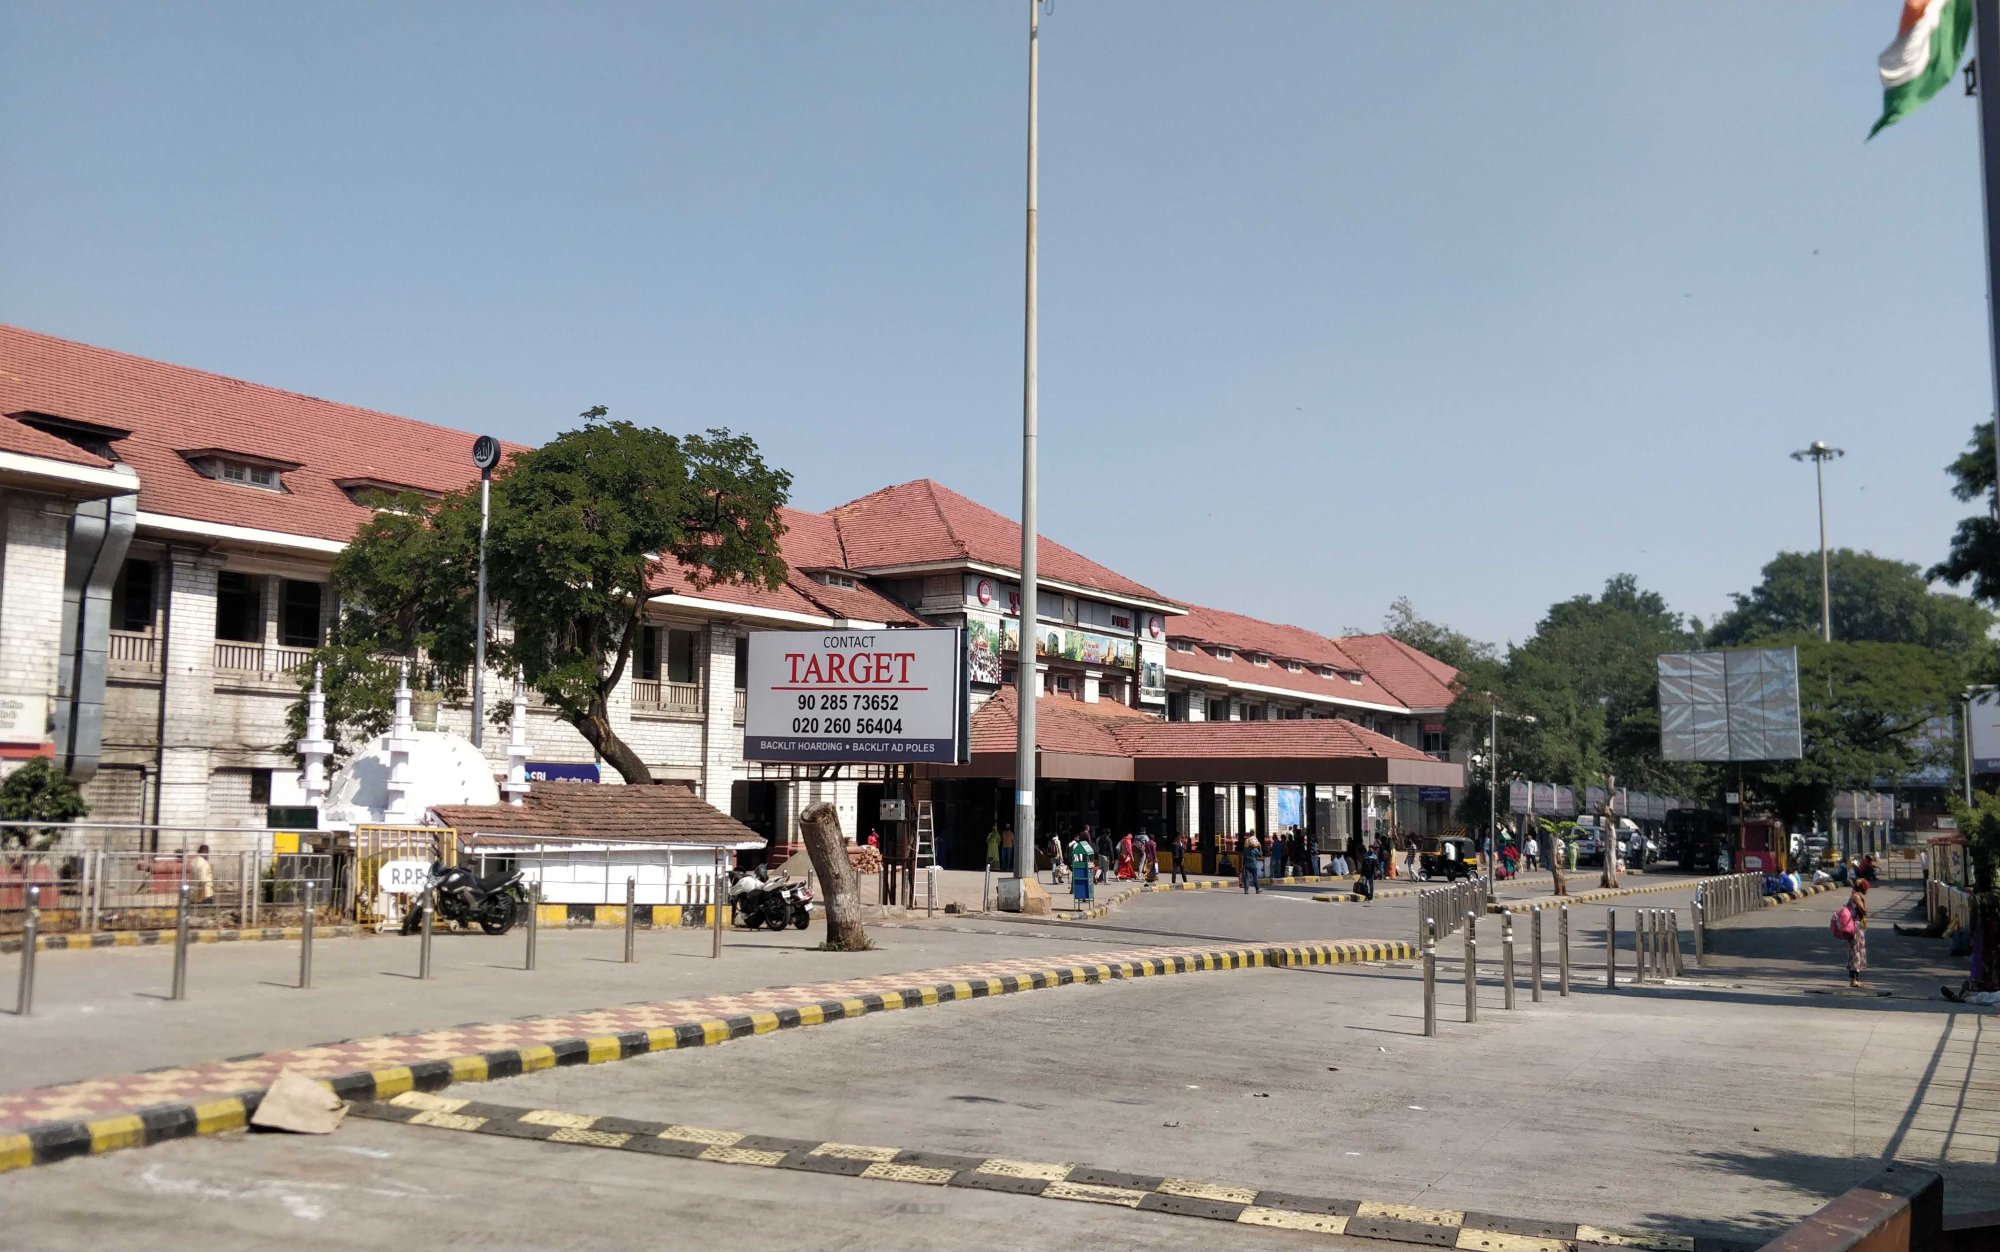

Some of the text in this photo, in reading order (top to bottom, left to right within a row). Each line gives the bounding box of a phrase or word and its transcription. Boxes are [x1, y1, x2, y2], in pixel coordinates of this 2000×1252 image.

[1112, 615, 1130, 629] PUNE
[823, 636, 876, 648] CONTACT
[784, 652, 916, 684] TARGET
[798, 694, 899, 711] 90 285 73652
[792, 717, 903, 735] 020 260 56404
[760, 740, 843, 751] BACKLIT HOARDING
[852, 742, 935, 753] BACKLIT AD POLES
[392, 868, 425, 885] R.P.F.
